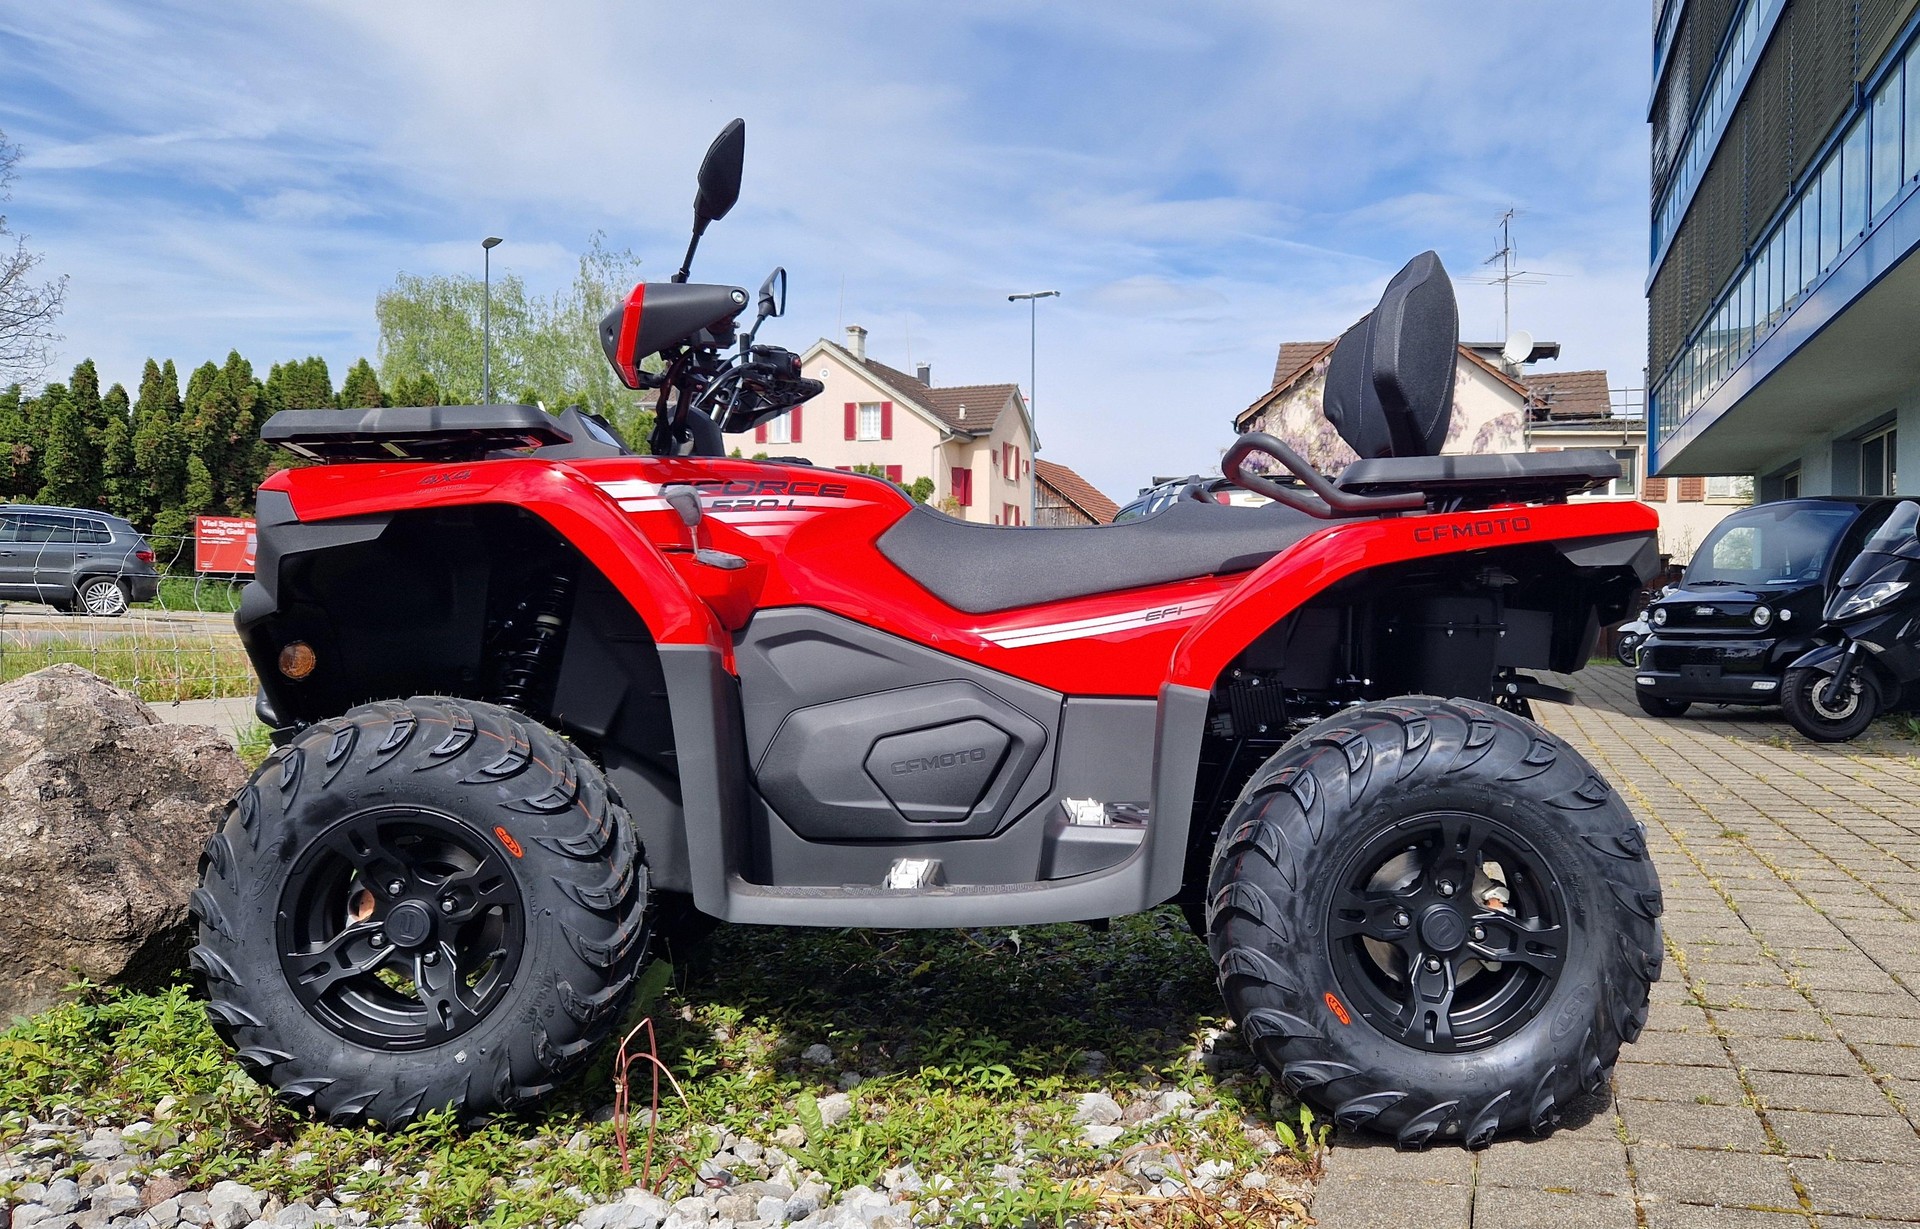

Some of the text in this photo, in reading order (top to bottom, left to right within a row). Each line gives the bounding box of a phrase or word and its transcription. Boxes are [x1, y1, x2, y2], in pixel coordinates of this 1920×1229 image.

[711, 499, 779, 512] 520
[201, 519, 217, 527] Viel
[219, 520, 243, 529] Speed
[1413, 517, 1531, 542] CFMOTO
[201, 528, 225, 536] wenig
[1145, 606, 1182, 621] EFI
[891, 747, 986, 776] CFMOTO
